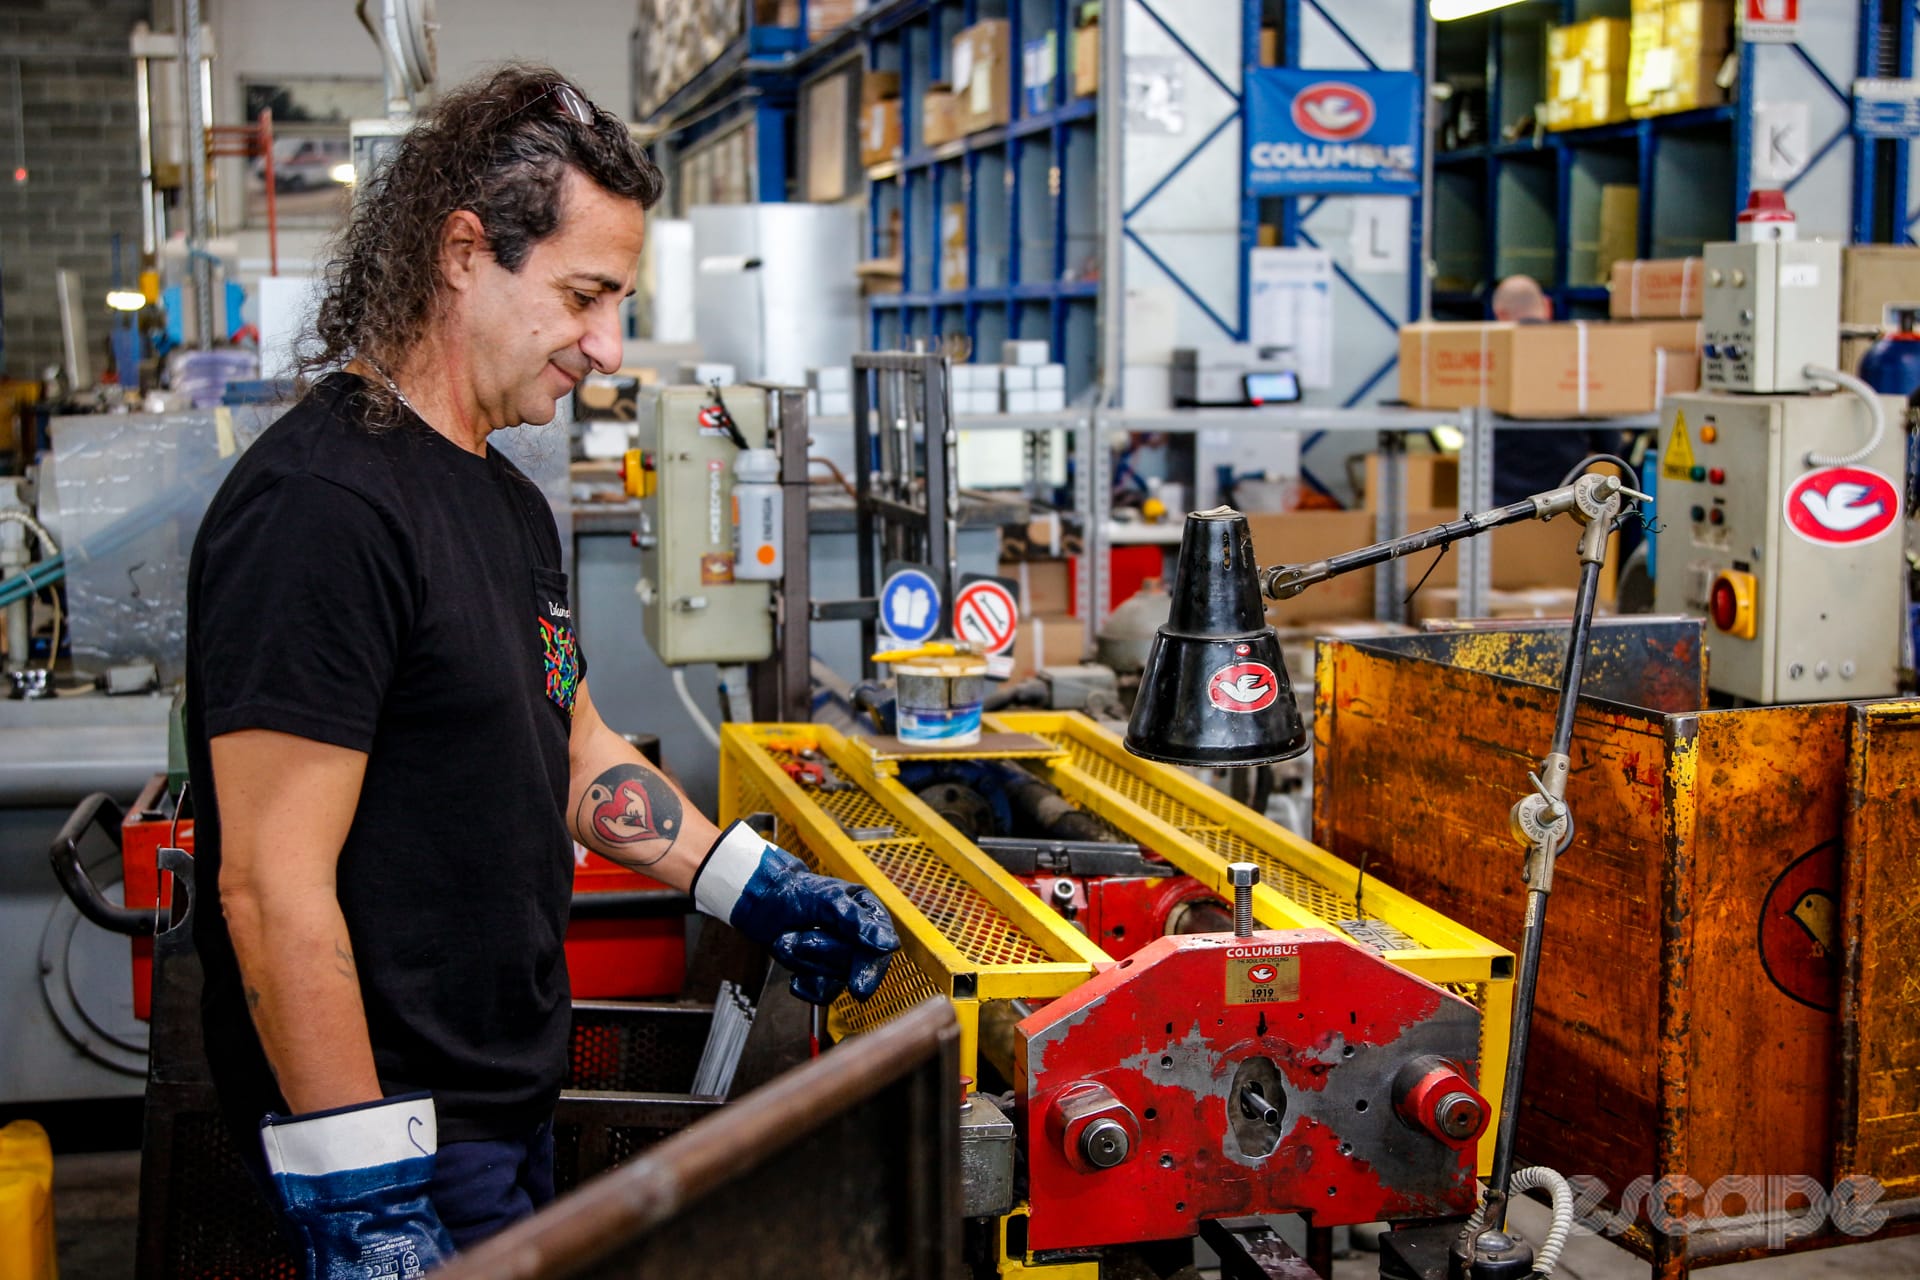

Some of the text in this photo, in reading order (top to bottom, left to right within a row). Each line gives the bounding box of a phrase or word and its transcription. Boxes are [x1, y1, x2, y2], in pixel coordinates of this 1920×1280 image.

[1250, 141, 1418, 169] COLUMBUS
[1768, 123, 1794, 167] K
[1370, 216, 1390, 258] L
[762, 497, 773, 542] ENERGIA
[1226, 944, 1299, 958] COLUMBUS
[1251, 988, 1274, 998] 1919
